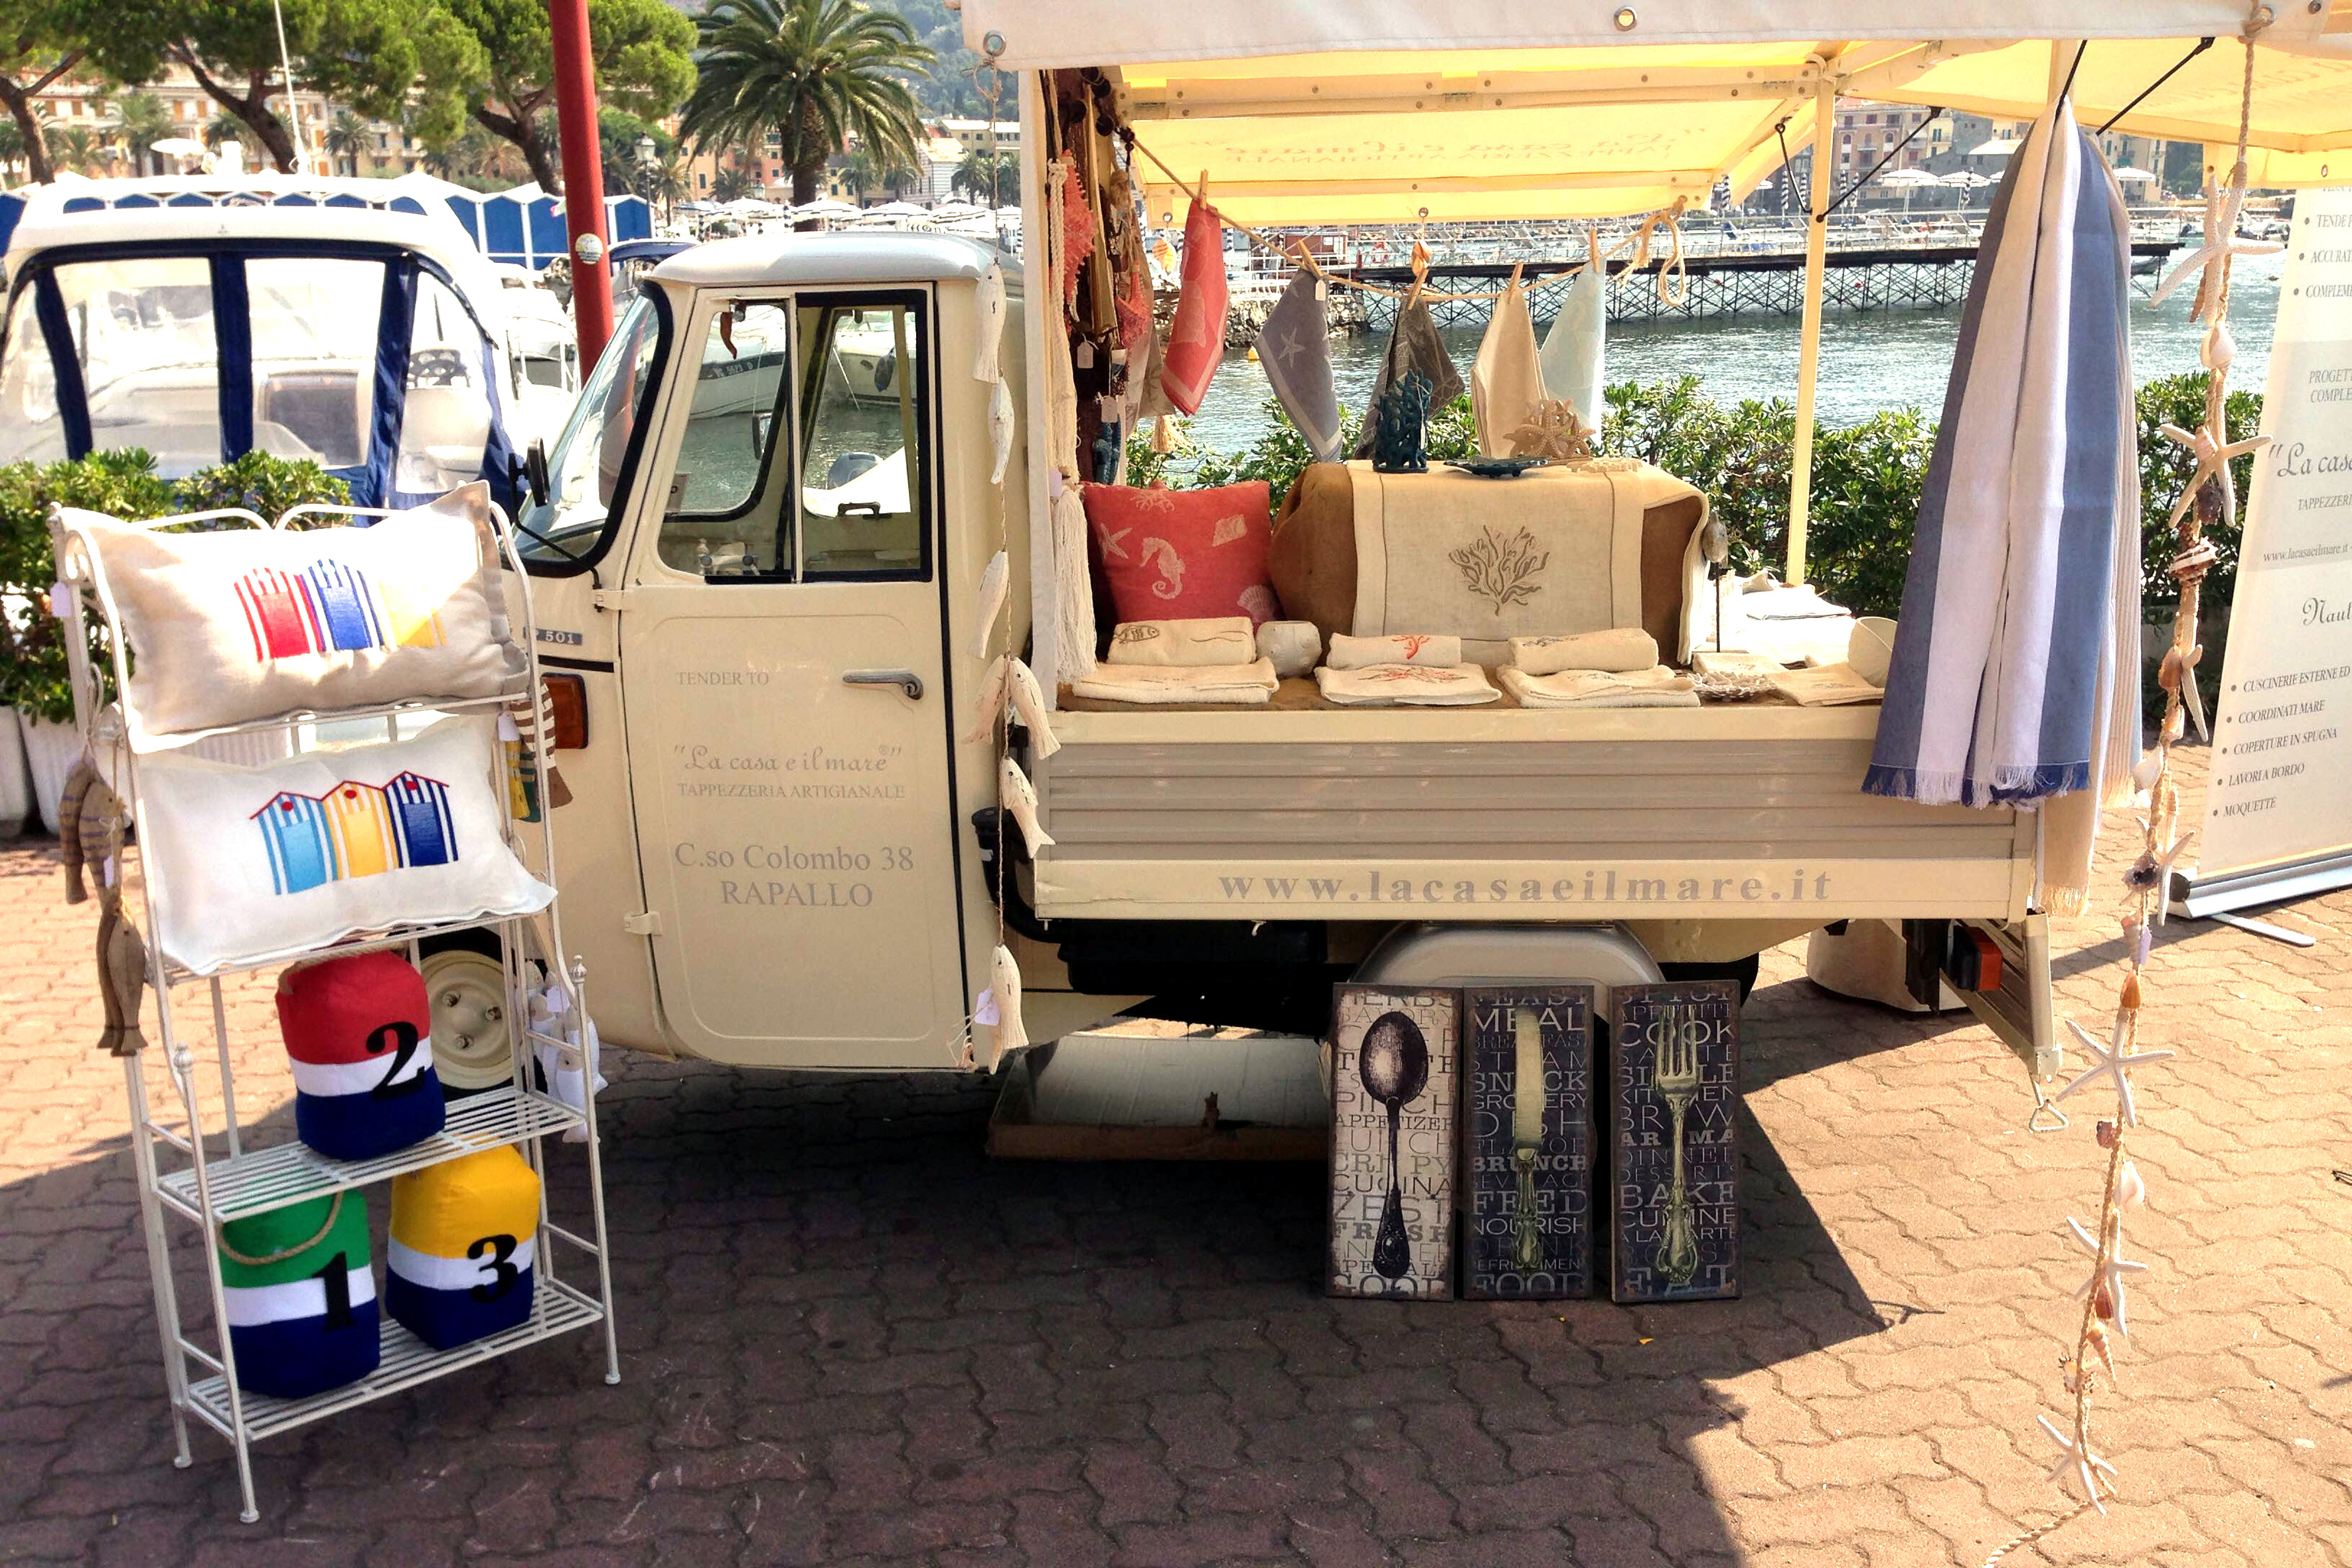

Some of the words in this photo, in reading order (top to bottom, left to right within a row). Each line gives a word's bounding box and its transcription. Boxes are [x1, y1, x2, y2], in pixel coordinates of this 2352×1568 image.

[2306, 284, 2352, 298] COMPLEM
[545, 631, 574, 644] 501
[676, 671, 742, 686] TENDER
[746, 672, 769, 686] TO
[2238, 704, 2298, 724] COORDINATI
[2300, 700, 2326, 715] MARE
[2233, 736, 2288, 755] COPERTURE
[2290, 734, 2301, 745] IN
[2302, 728, 2337, 744] SPUGNA
[729, 757, 779, 771] casa
[785, 758, 797, 771] e
[803, 745, 824, 771] il
[2271, 763, 2305, 779] BORDO
[677, 782, 786, 798] TAPPEZZERIA
[789, 785, 906, 799] ARTIGIANALE
[2224, 797, 2277, 817] MOQUETTE
[674, 842, 734, 868] C.so
[744, 844, 871, 871] Colombo
[881, 846, 914, 871] 38
[720, 880, 873, 907] RAPALLO
[1218, 869, 1832, 902] www.lacasaeilmare.it
[366, 1020, 425, 1101] 2
[1474, 1071, 1588, 1093] SNCK
[1474, 1093, 1588, 1109] GROERY
[1620, 1129, 1736, 1147] ARMA
[466, 1233, 519, 1304] 3
[311, 1251, 358, 1334] 1
